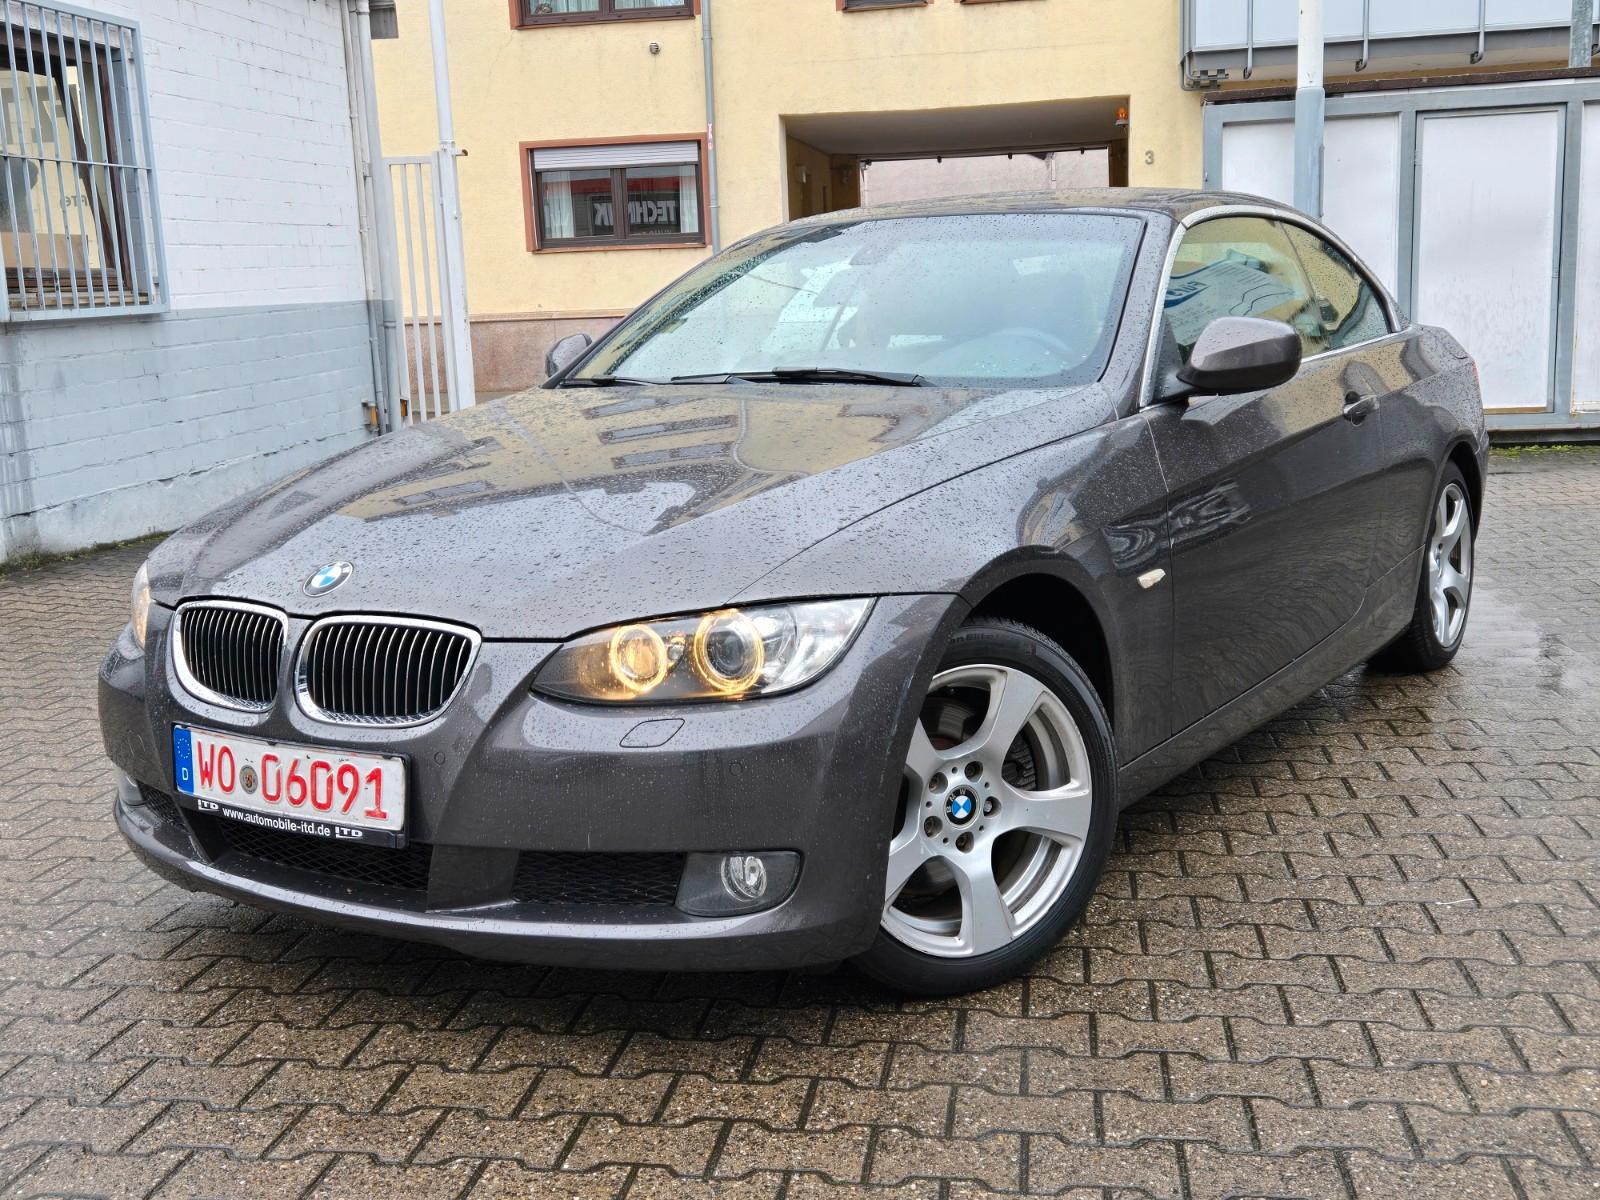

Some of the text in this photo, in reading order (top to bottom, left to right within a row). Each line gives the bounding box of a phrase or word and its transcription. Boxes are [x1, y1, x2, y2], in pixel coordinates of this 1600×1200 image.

[1145, 150, 1154, 165] 3
[182, 767, 189, 781] D
[197, 741, 235, 793] WO
[261, 754, 387, 819] 06091
[222, 807, 331, 837] www.automobile-itd.de
